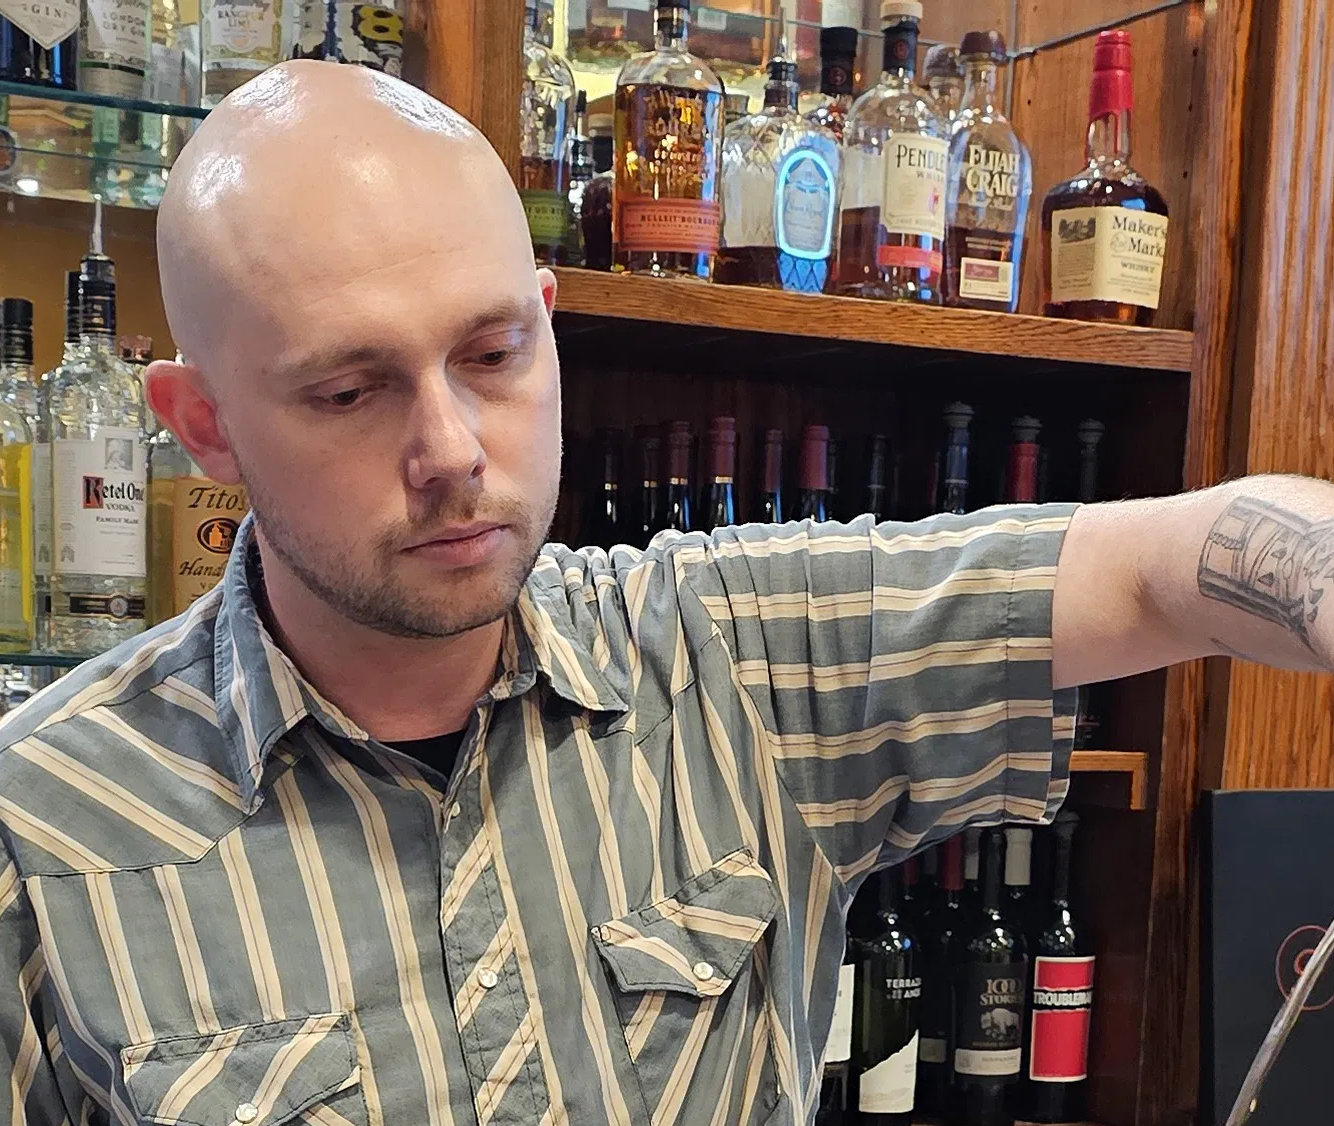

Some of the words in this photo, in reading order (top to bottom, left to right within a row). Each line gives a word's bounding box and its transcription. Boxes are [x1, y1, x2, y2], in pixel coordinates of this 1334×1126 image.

[969, 144, 1020, 170] ELIJAH
[967, 167, 1019, 197] CRAIG
[1128, 236, 1164, 258] Mark
[82, 476, 125, 508] Ketel
